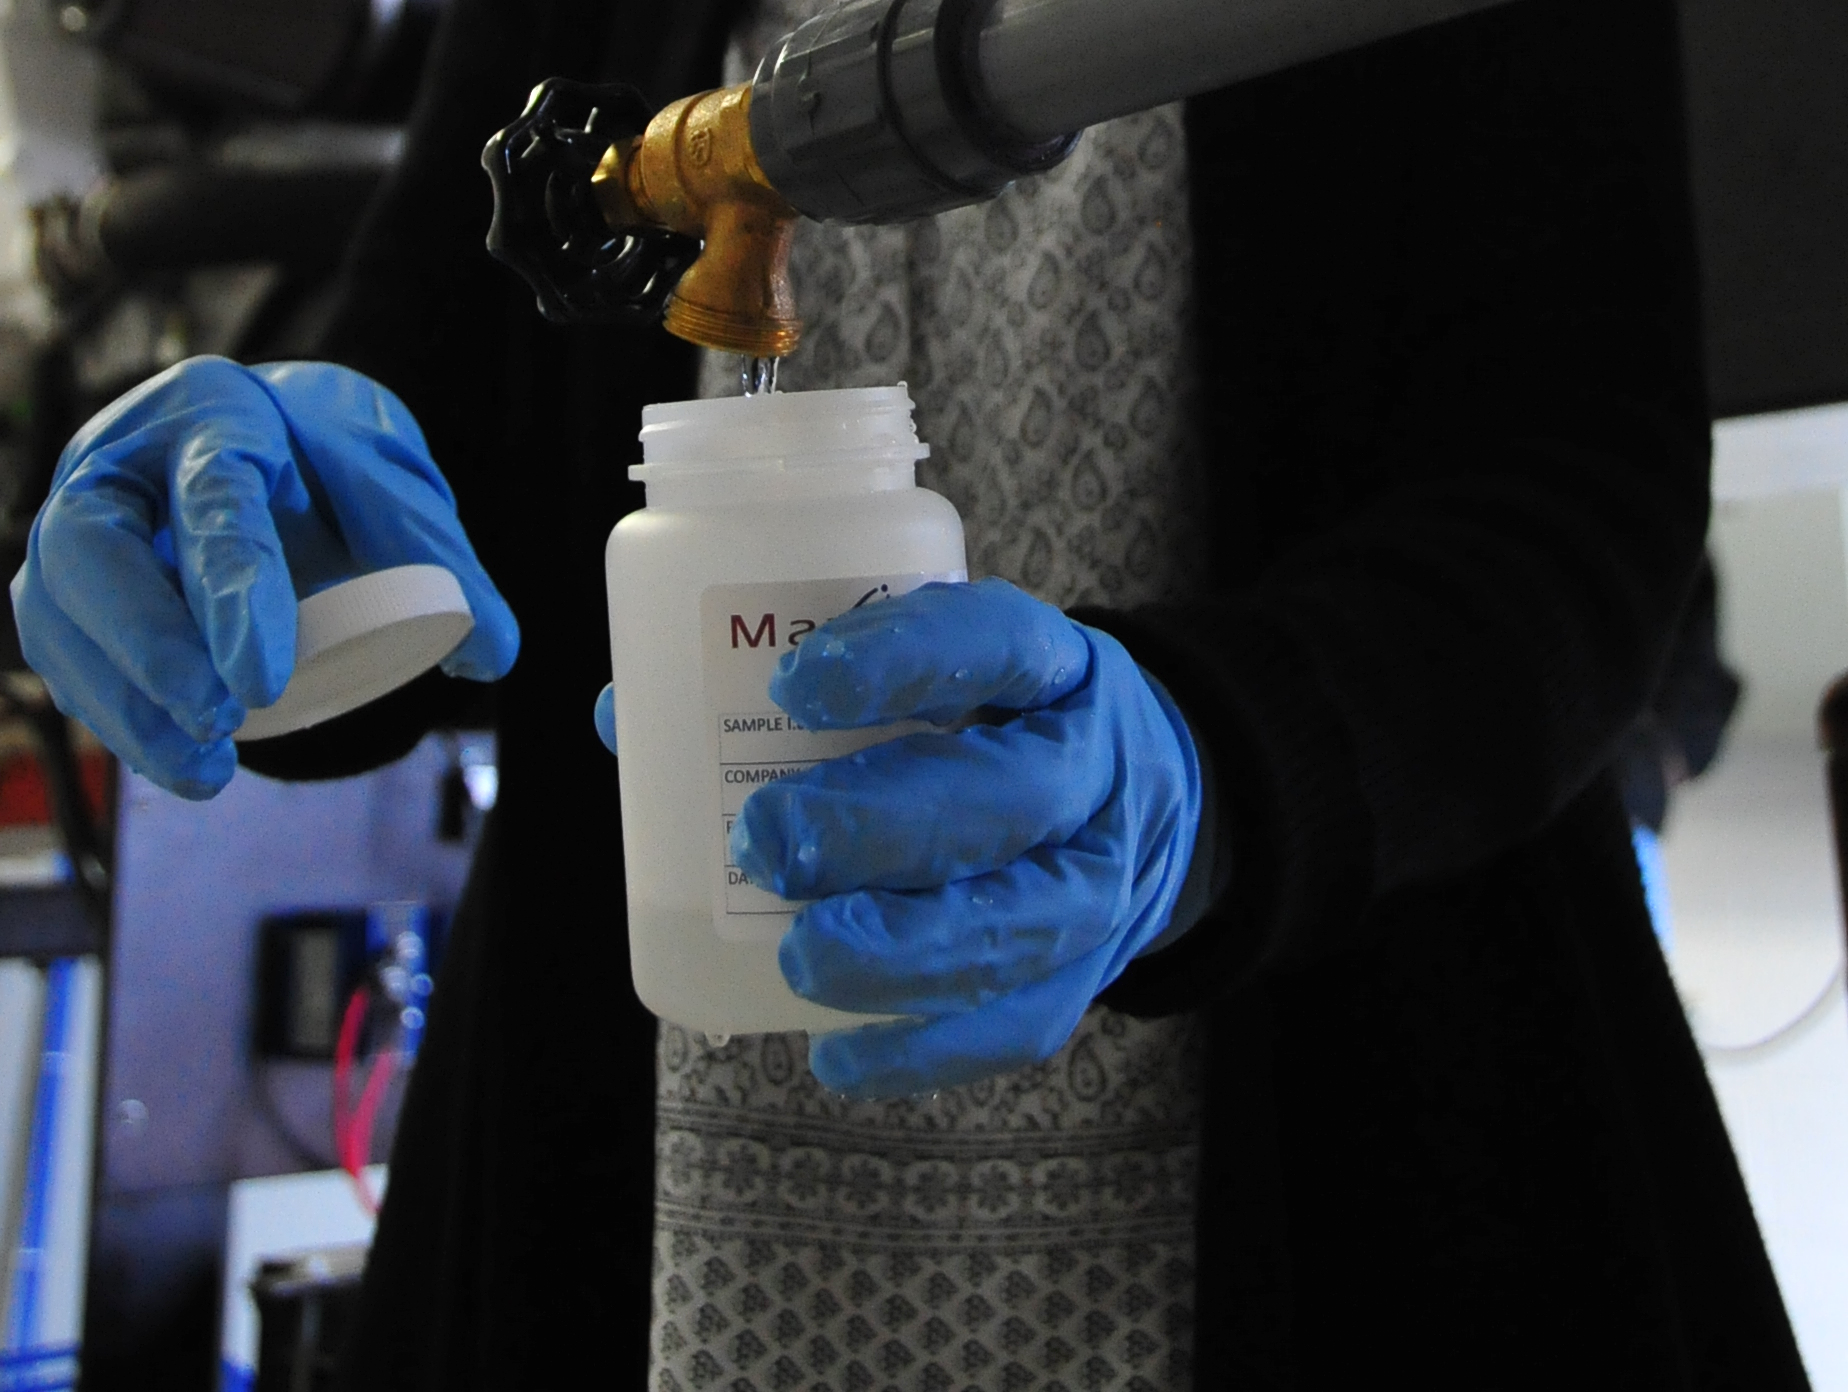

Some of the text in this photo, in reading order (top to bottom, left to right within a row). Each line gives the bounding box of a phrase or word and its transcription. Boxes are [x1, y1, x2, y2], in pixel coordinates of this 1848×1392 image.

[730, 613, 830, 649] Ma
[723, 716, 805, 733] SAMPLE I.
[728, 871, 753, 885] DA
